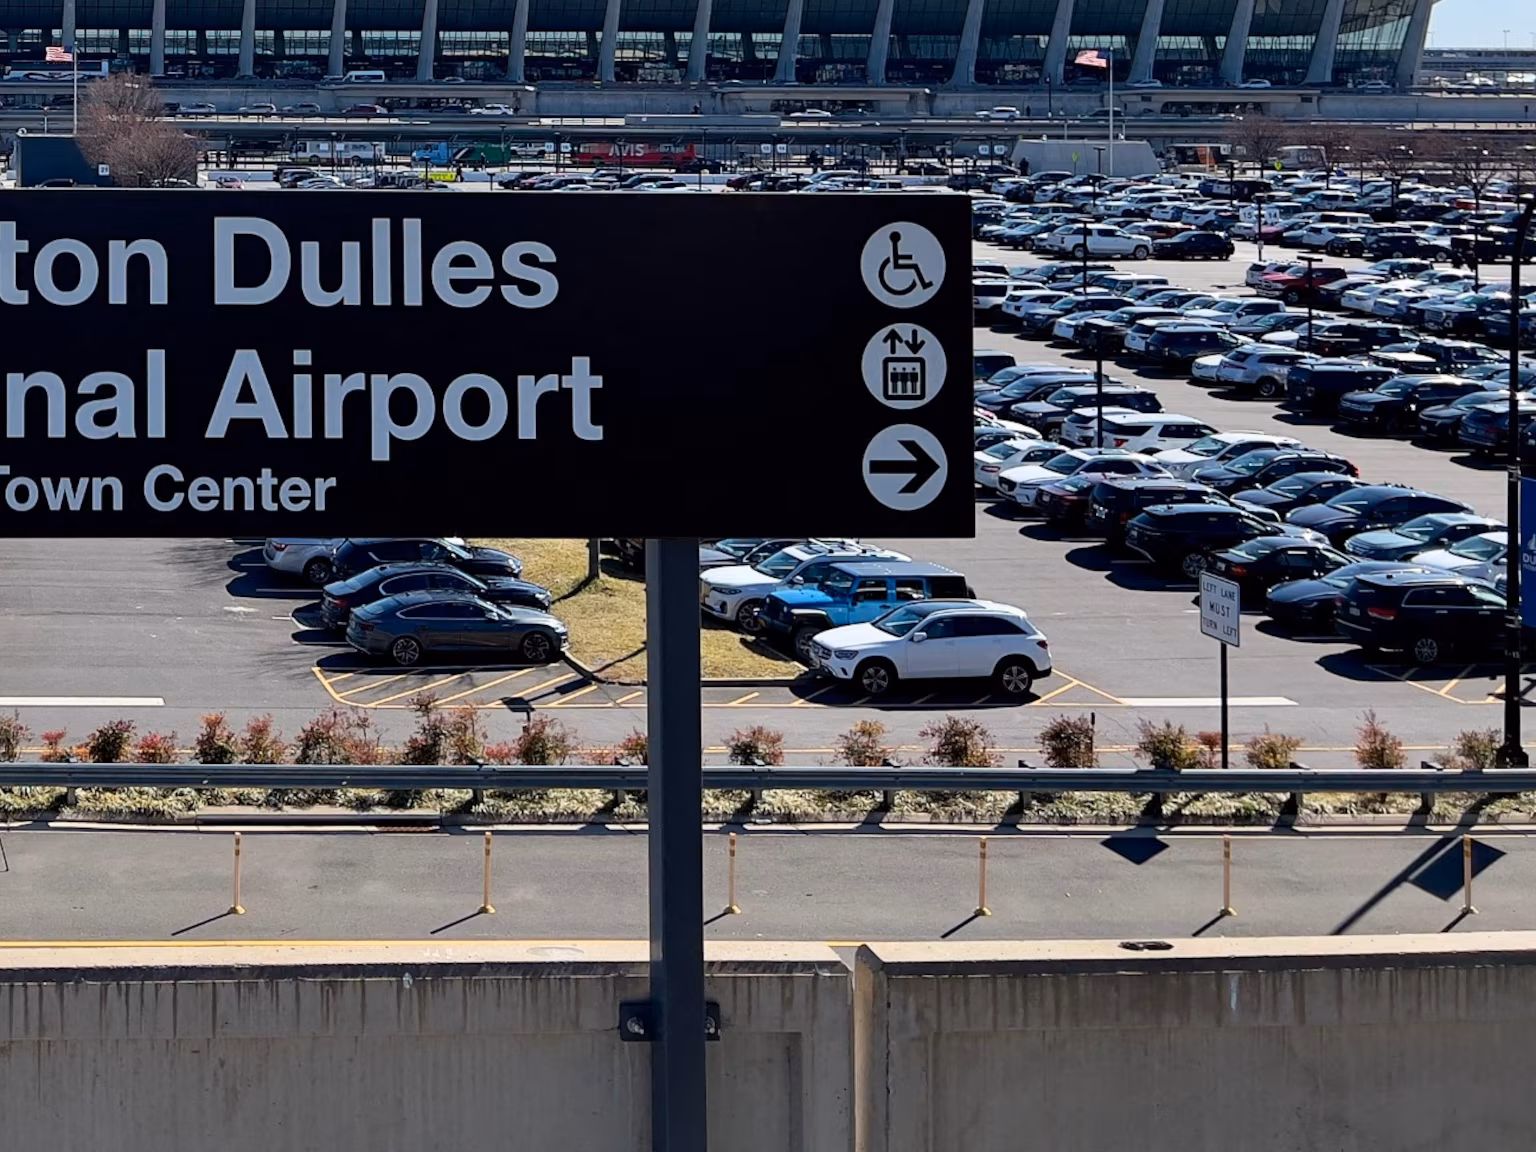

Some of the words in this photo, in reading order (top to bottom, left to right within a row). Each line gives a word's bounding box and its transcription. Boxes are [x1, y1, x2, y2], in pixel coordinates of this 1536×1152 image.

[609, 143, 644, 156] AVIS
[214, 217, 559, 308] Dulles
[205, 349, 603, 461] Airport
[144, 464, 336, 511] Center
[1203, 581, 1217, 594] LEFT
[1221, 588, 1236, 602] LANE
[1209, 601, 1230, 618] MUST
[1203, 617, 1217, 630] TURN
[1222, 624, 1237, 637] LEFT
